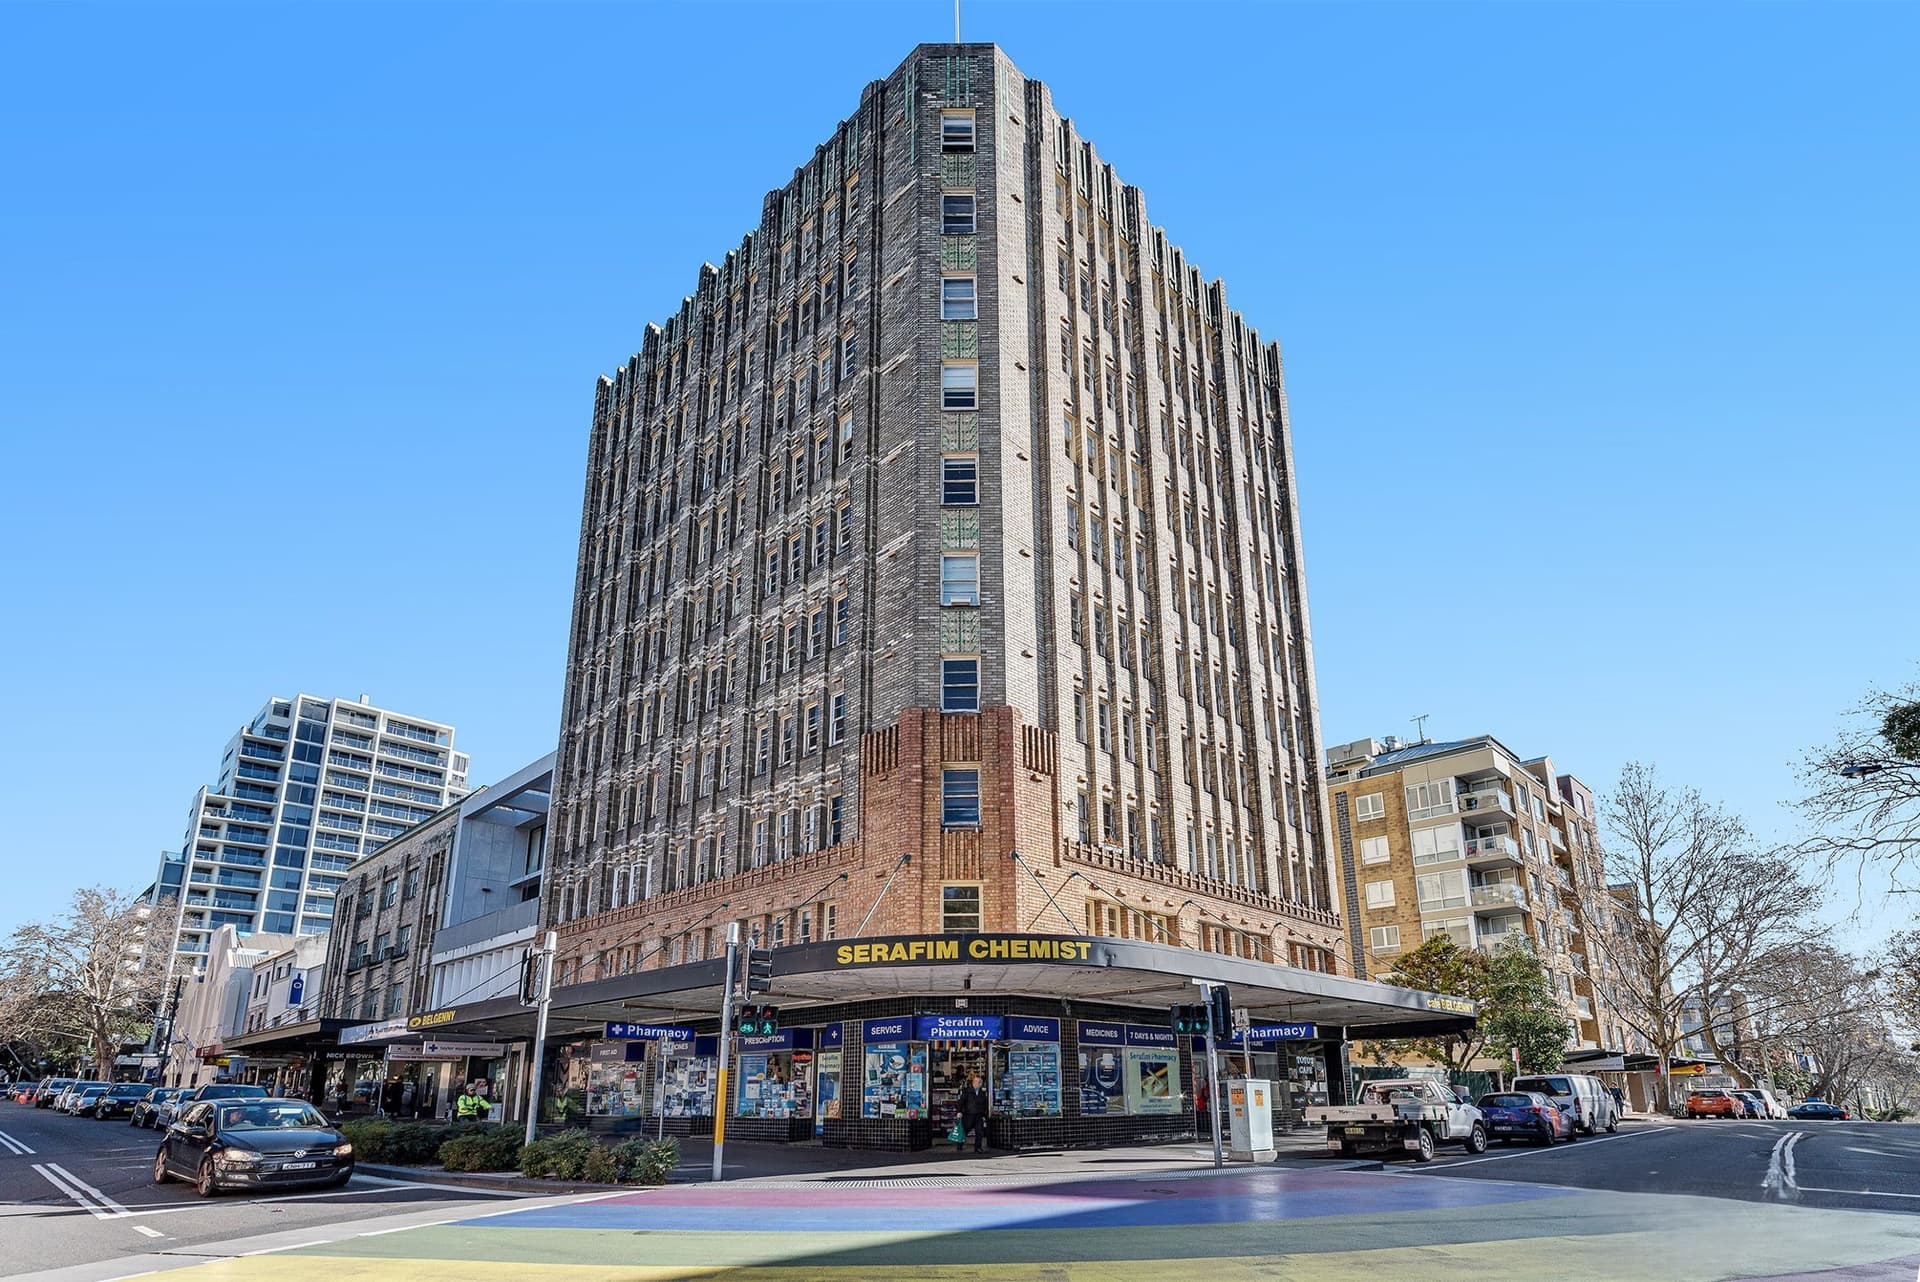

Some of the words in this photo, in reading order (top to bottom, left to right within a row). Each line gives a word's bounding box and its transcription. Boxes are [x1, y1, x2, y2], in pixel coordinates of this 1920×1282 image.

[836, 941, 959, 964] SERAFIM
[968, 939, 1092, 961] CHEMIST
[421, 1010, 456, 1026] BELGENNY
[938, 1017, 984, 1027] Serafim
[627, 1024, 689, 1040] Pharmacy
[870, 1024, 902, 1036] SERVICE
[931, 1027, 991, 1039] Pharmacy
[1023, 1024, 1049, 1034] ADVICE
[1085, 1028, 1119, 1039] MEDICINES
[744, 1034, 785, 1046] PRESCRIPTION
[1129, 1031, 1134, 1040] 7
[1134, 1032, 1149, 1040] DAYS
[1154, 1033, 1174, 1042] NIGHTS
[1298, 1066, 1313, 1074] CAFE
